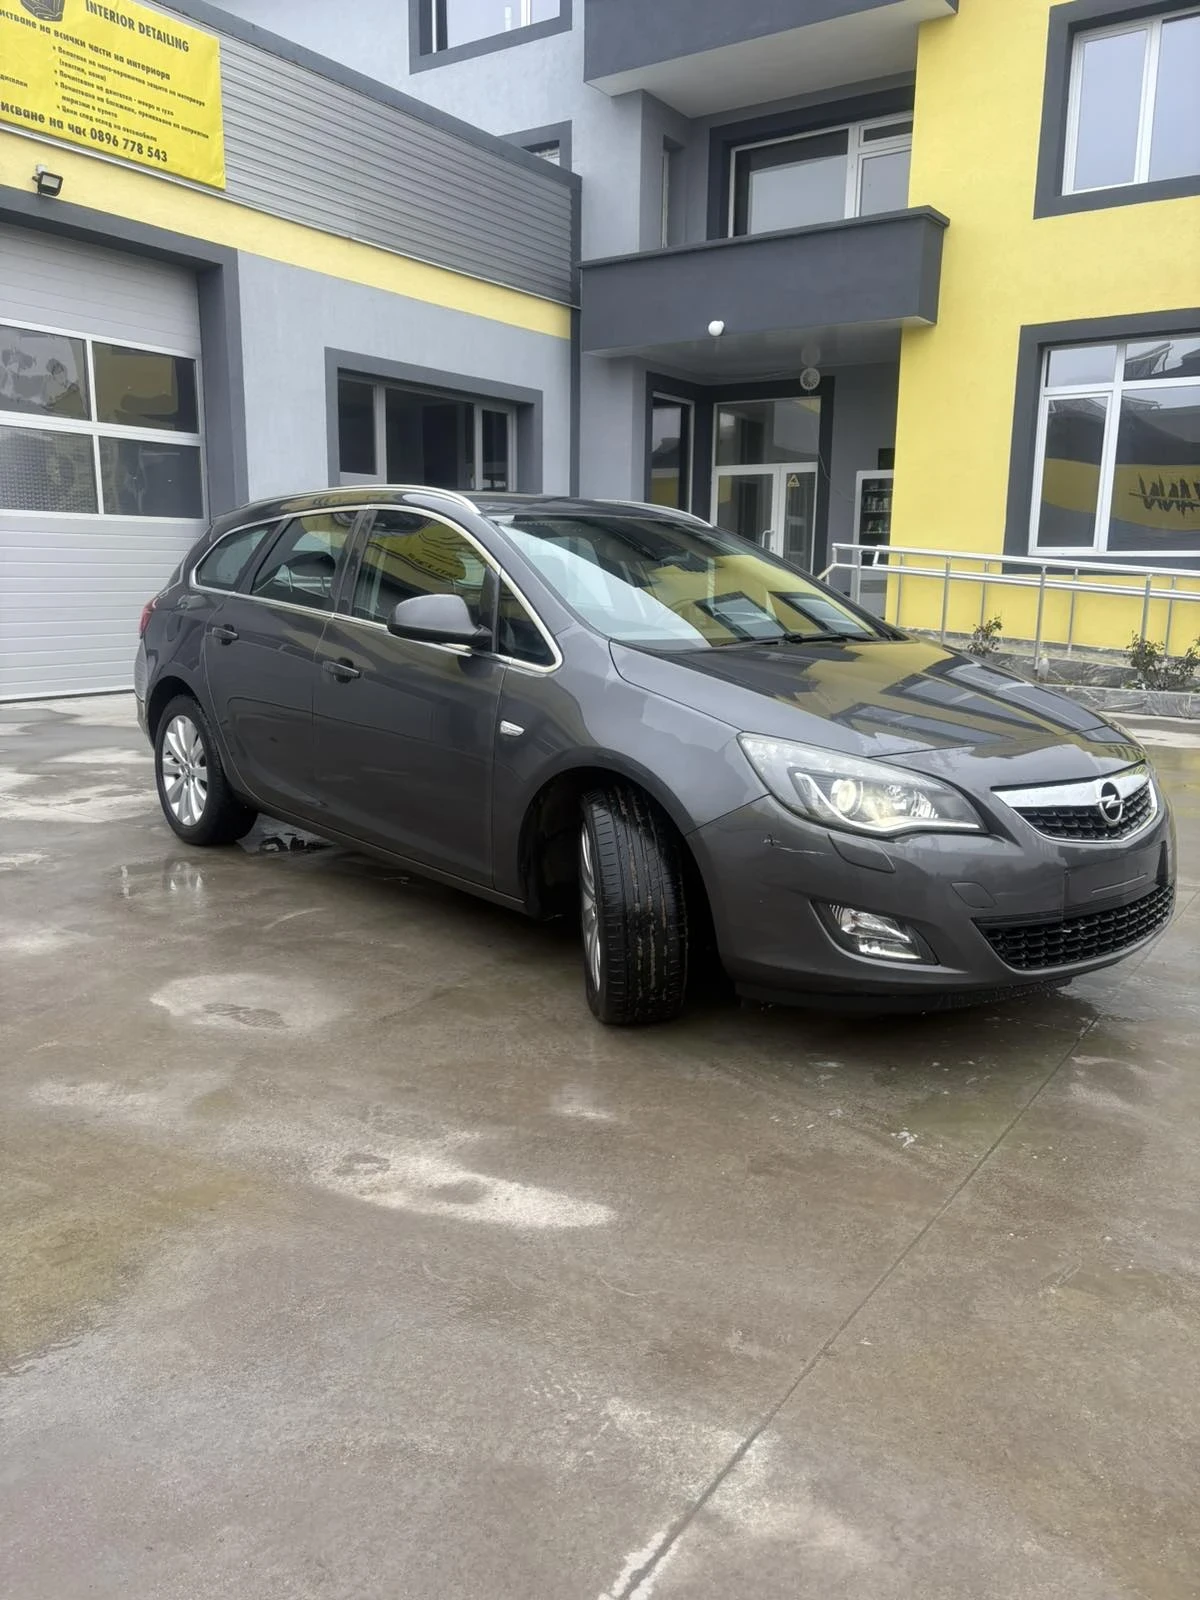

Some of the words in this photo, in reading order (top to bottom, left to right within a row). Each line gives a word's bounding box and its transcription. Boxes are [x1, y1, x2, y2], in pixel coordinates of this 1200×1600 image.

[40, 24, 51, 34] на
[54, 29, 86, 48] всички
[88, 43, 112, 58] части
[114, 53, 124, 63] на
[126, 58, 171, 80] интериора
[86, 0, 135, 31] INTERIOR
[138, 21, 189, 52] DETAILING
[49, 117, 64, 130] на
[67, 123, 87, 137] час
[90, 127, 119, 147] 0896
[122, 138, 144, 155] 778
[147, 146, 168, 163] 543
